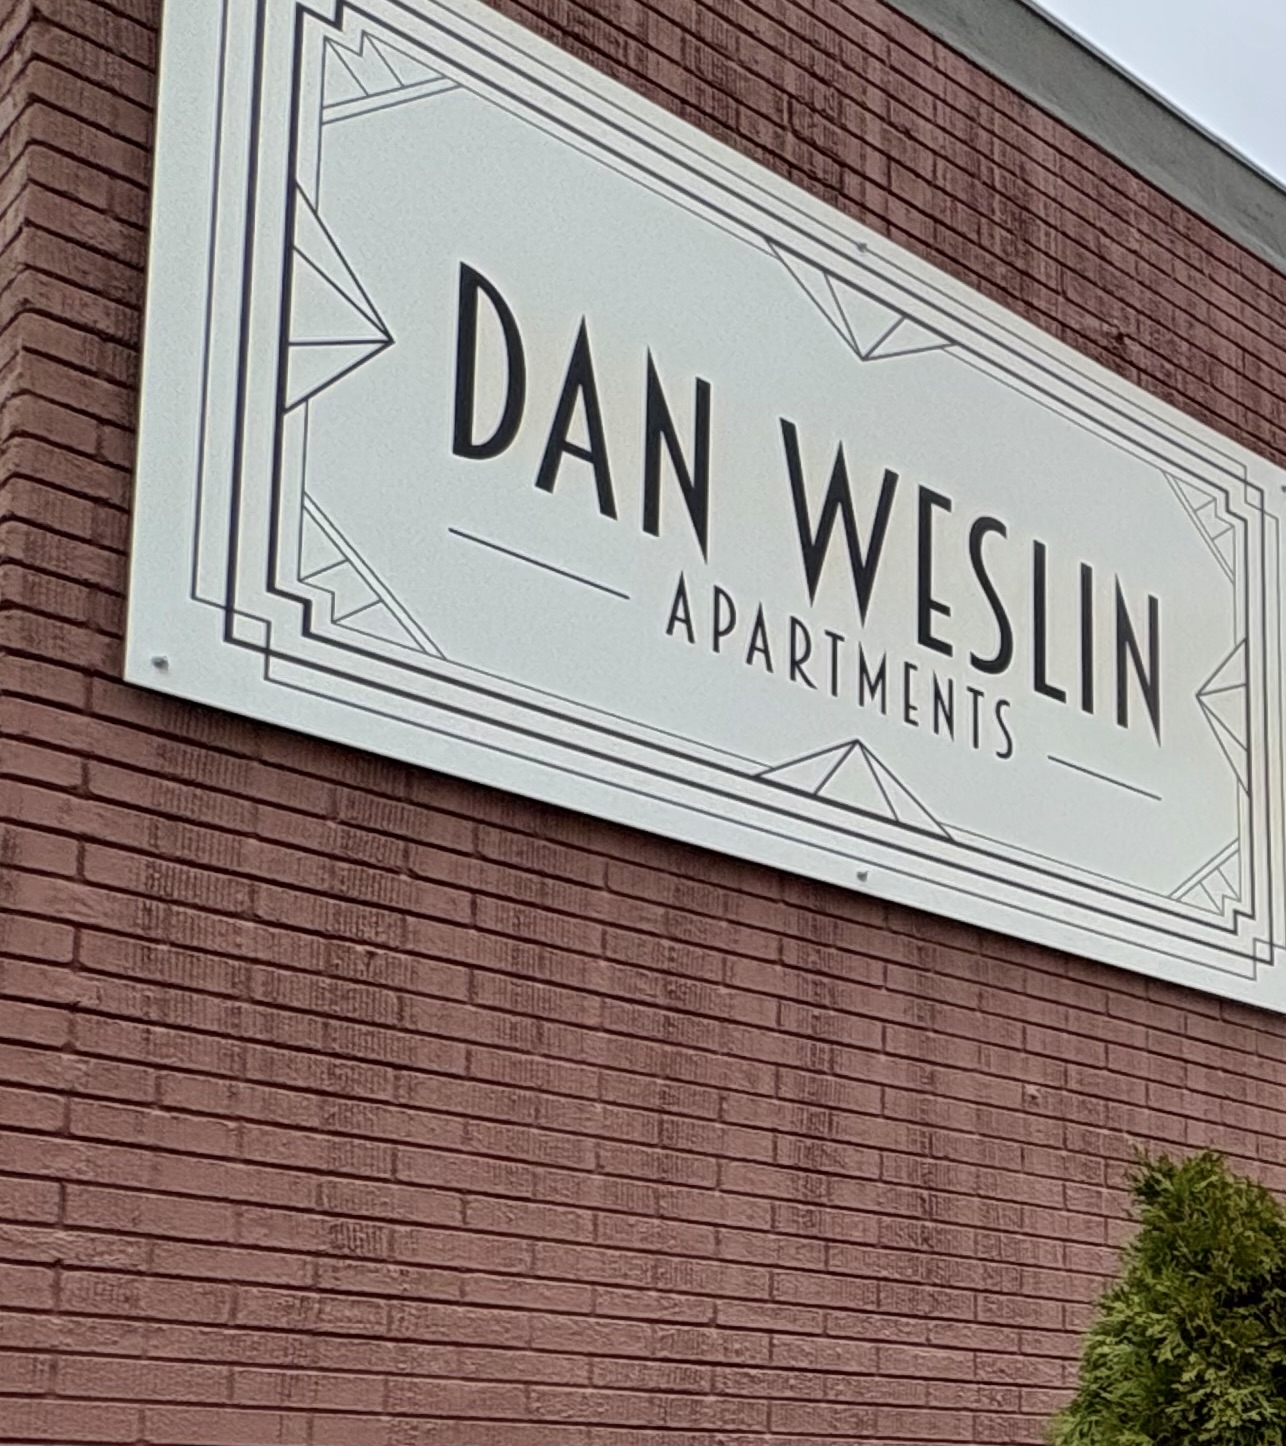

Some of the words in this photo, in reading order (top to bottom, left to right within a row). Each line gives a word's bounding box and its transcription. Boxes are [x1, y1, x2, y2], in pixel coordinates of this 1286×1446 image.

[452, 261, 711, 562] DAN
[780, 417, 1161, 743] WESLIN
[666, 573, 1013, 759] APARTMENTS
